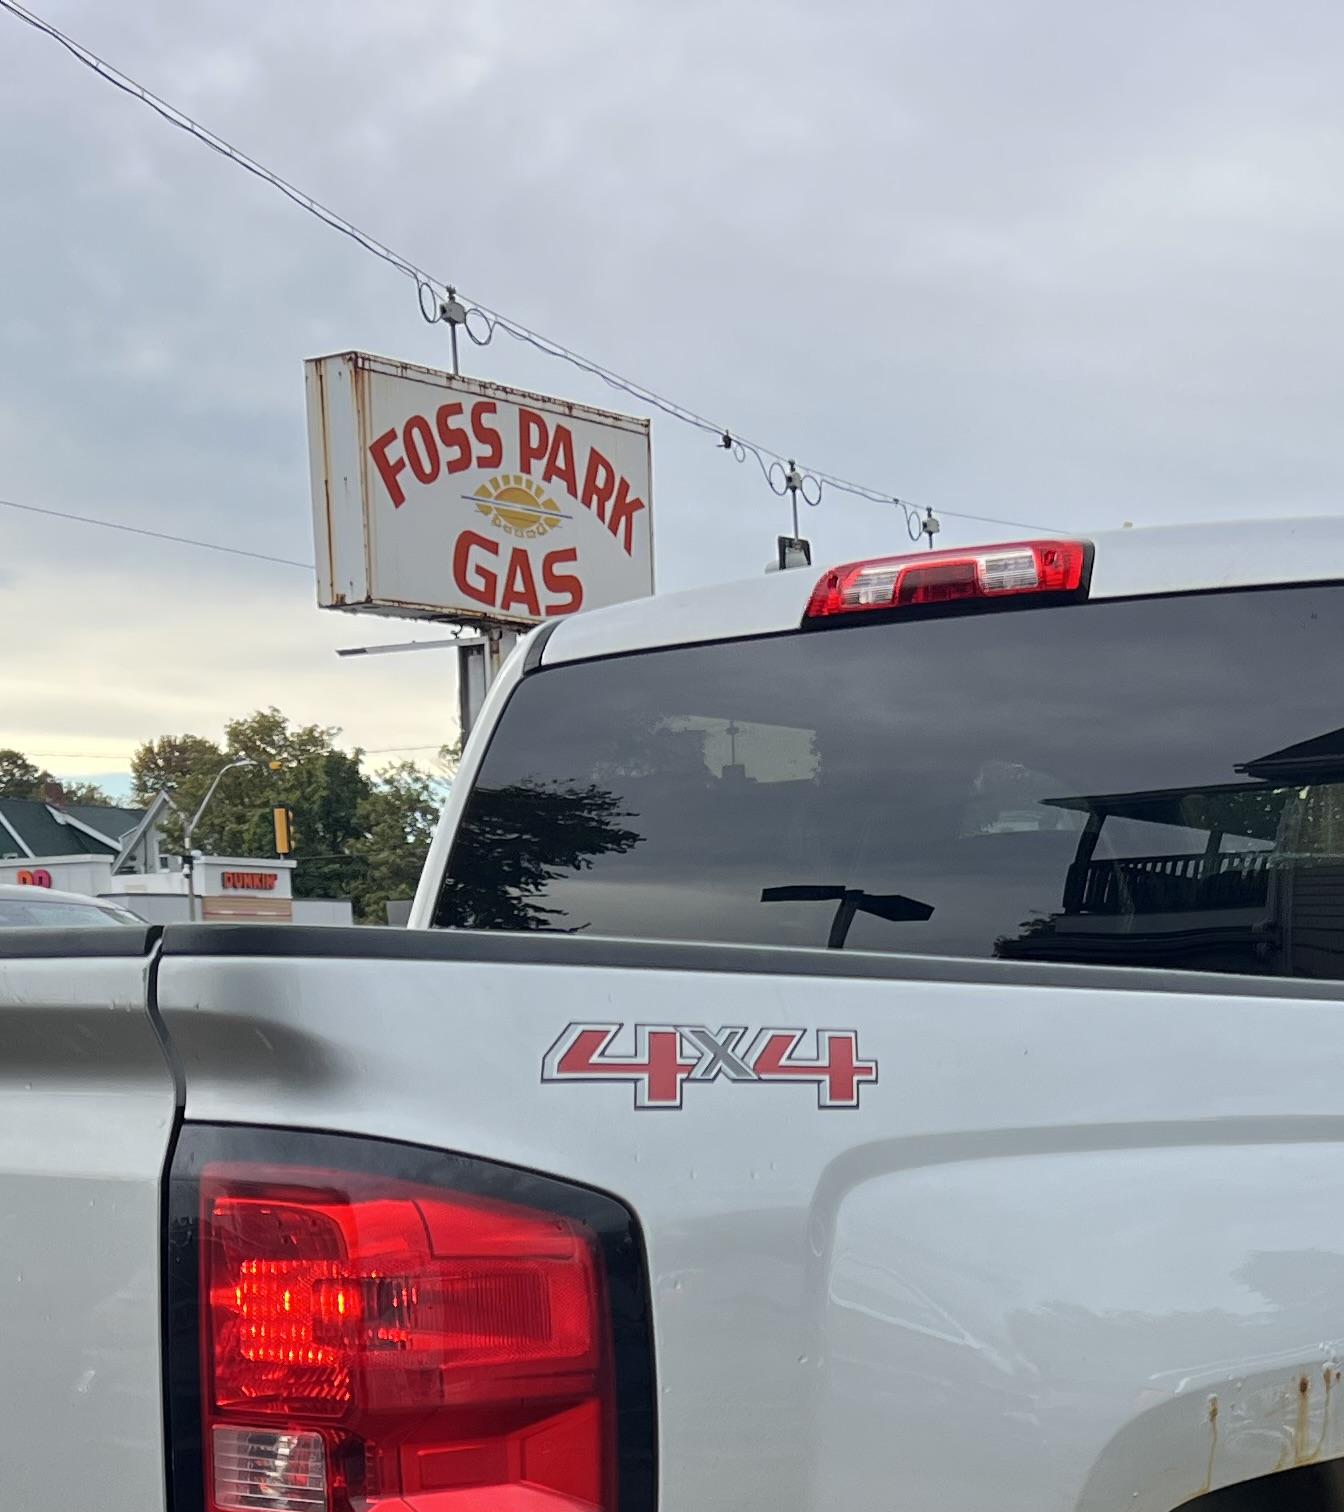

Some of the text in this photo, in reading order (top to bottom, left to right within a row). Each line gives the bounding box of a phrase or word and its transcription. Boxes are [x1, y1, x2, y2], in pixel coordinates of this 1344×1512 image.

[369, 401, 645, 557] FOSS PARK
[453, 530, 584, 617] GAS
